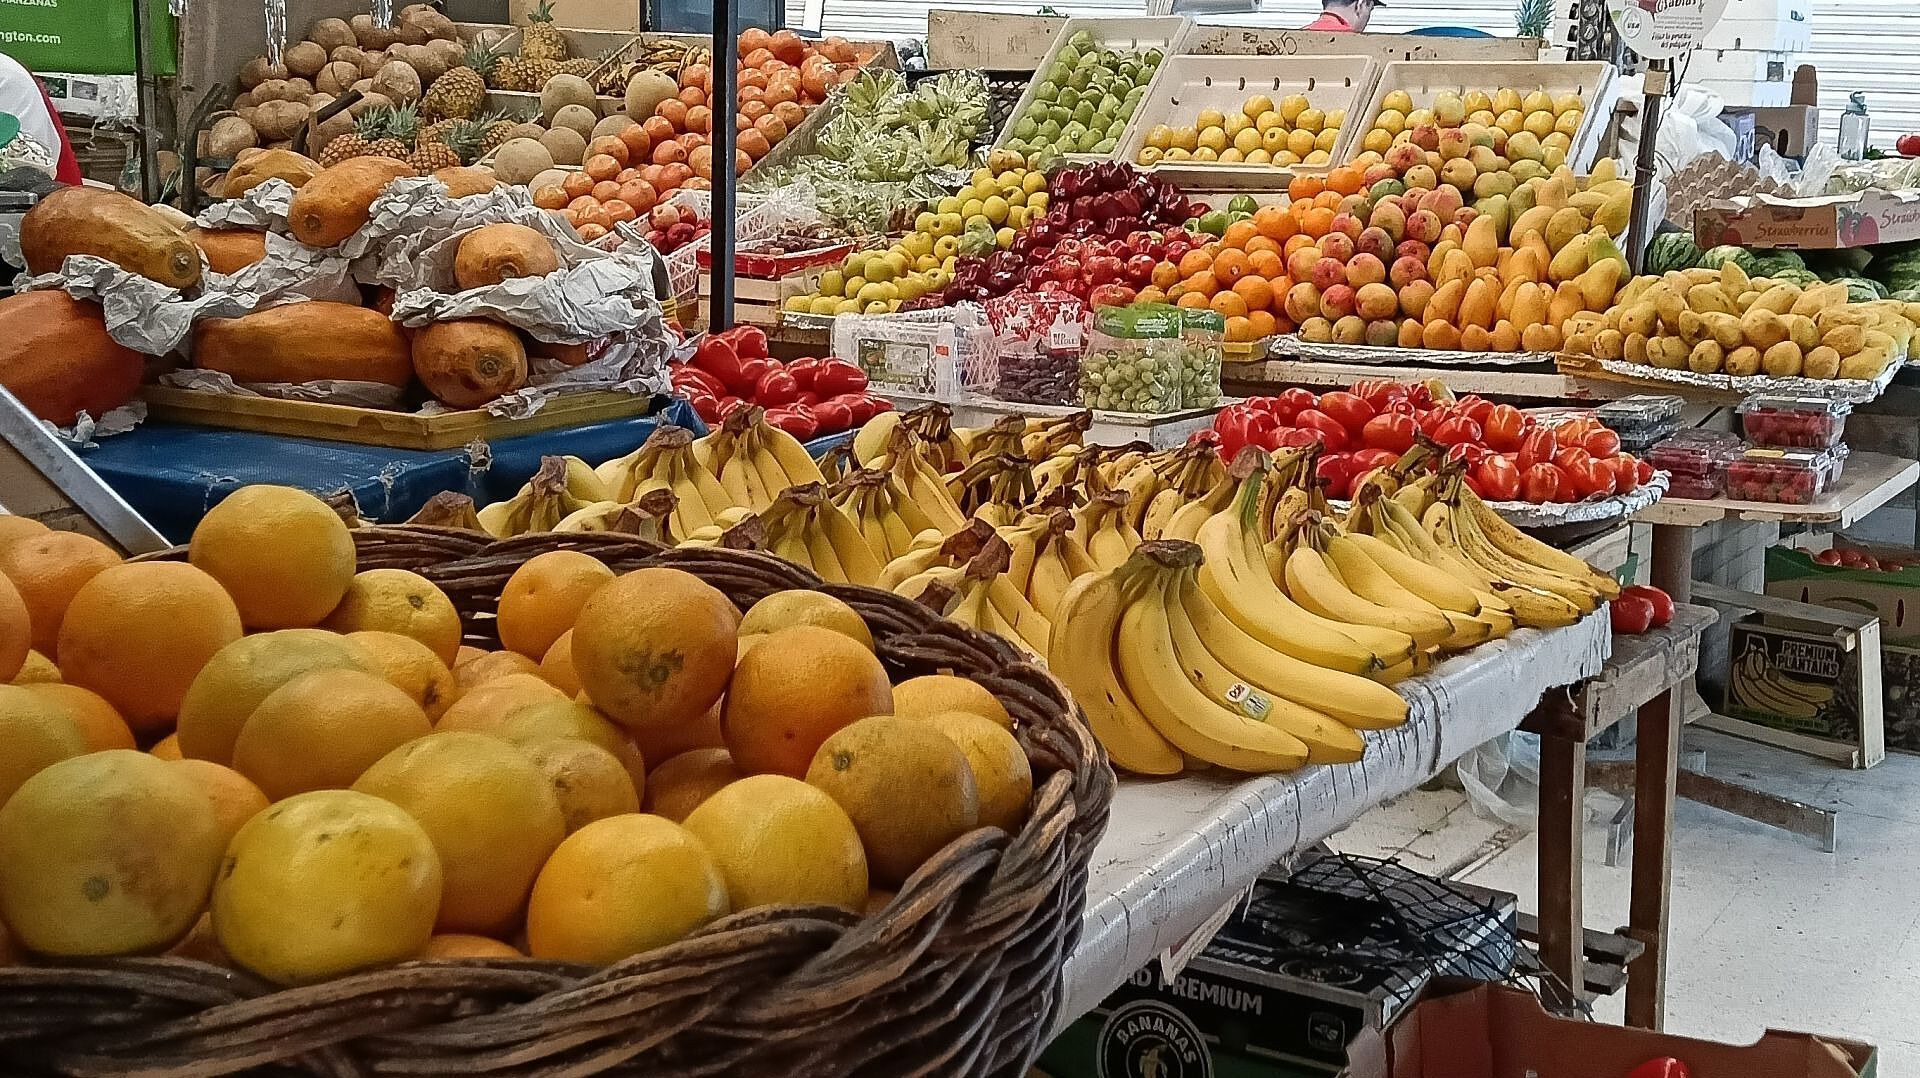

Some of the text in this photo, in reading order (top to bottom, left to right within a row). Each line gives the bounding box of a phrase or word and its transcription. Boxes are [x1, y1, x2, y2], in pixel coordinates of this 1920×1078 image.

[1755, 223, 1830, 240] Strawberries
[1782, 640, 1837, 662] PREMIUM
[1776, 653, 1839, 678] PLANTAINS
[1116, 1016, 1197, 1064] BANANAS
